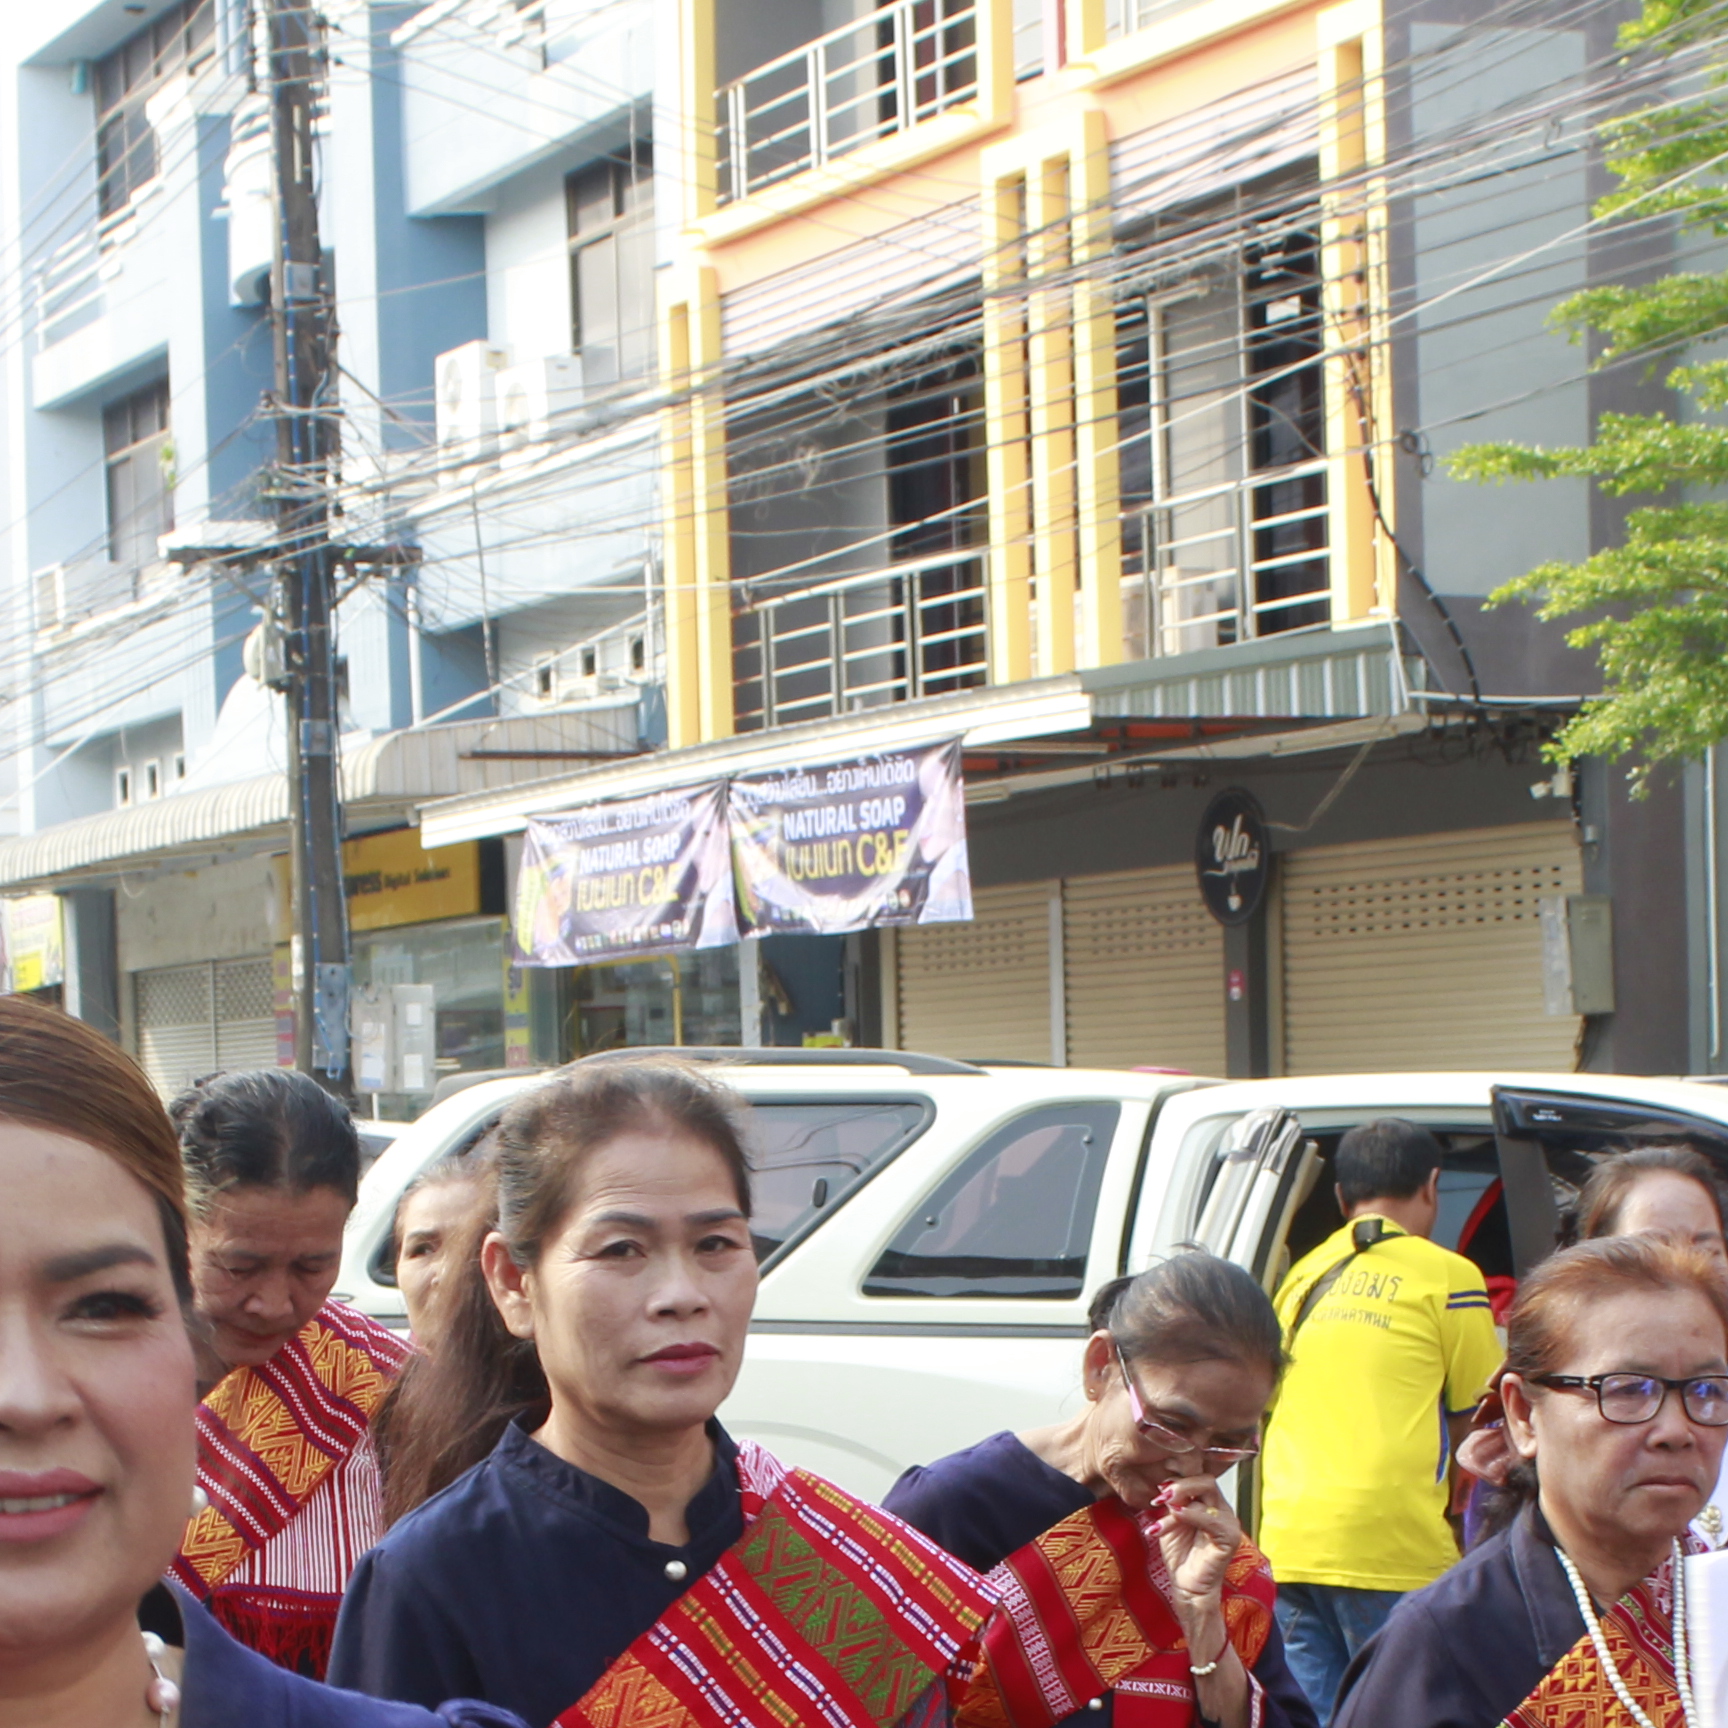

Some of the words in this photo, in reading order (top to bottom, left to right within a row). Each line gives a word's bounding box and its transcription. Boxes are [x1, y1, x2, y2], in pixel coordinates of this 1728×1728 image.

[783, 803, 858, 841] NATURAL
[859, 796, 906, 830] SOAP
[579, 839, 640, 874] NATURAL
[642, 832, 681, 865] SOAP
